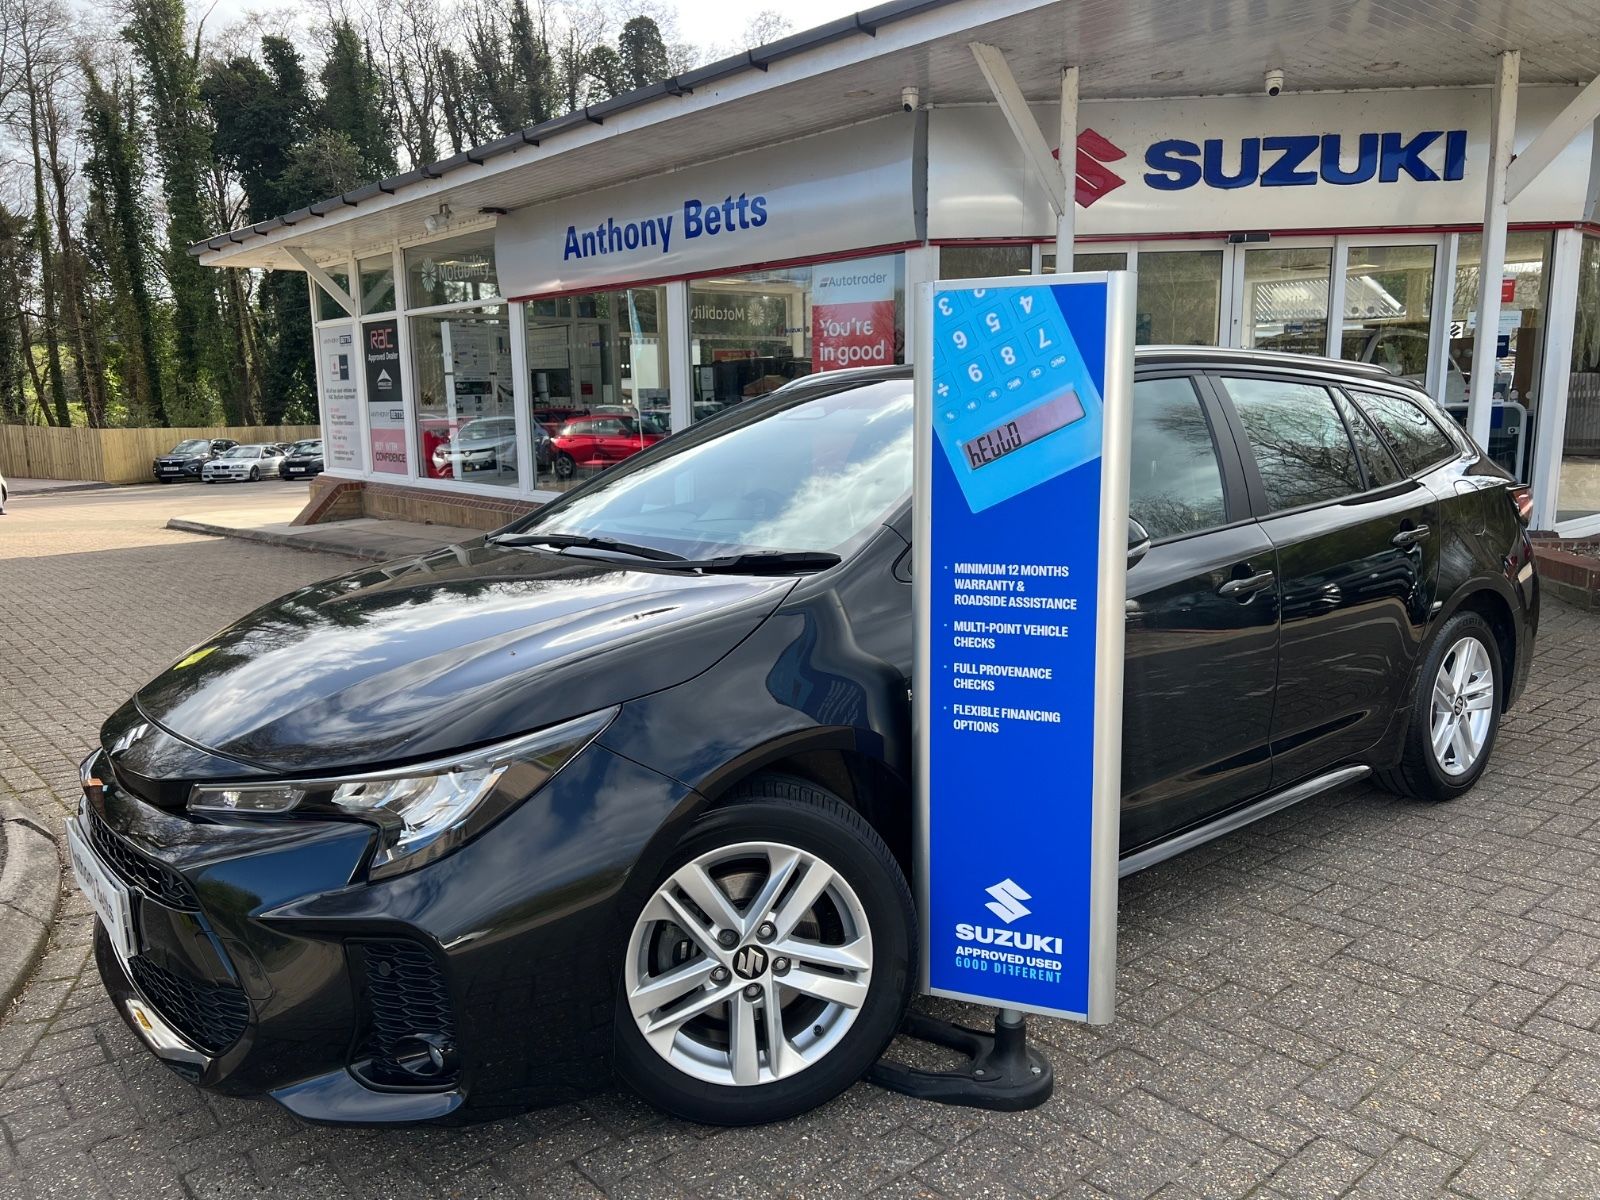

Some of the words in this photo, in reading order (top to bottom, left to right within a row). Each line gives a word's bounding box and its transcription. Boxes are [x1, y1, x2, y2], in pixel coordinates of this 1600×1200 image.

[1144, 130, 1467, 190] SUZUKI
[564, 217, 673, 260] Anthony
[684, 192, 767, 239] Betts
[828, 273, 887, 288] Autotrader
[938, 297, 953, 316] 3
[1020, 295, 1033, 314] 4
[821, 317, 873, 337] You're
[985, 312, 1001, 333] 5
[1038, 328, 1052, 349] 7
[820, 343, 836, 361] in
[837, 339, 885, 366] good
[1000, 345, 1016, 365] 8
[375, 452, 406, 463] CONFIDENCE
[954, 563, 1006, 575] MINIMUM
[1007, 564, 1019, 576] 12
[1020, 565, 1069, 578] MONTHS
[954, 578, 1016, 591] WARRANTY
[1016, 581, 1025, 592] &
[954, 594, 1007, 607] ROADSIDE
[1008, 596, 1077, 610] ASSISTANCE
[954, 621, 1021, 635] MULTI-POINT
[1023, 624, 1068, 637] VEHICLE
[954, 636, 996, 649] CHECKS
[954, 663, 980, 675] FULL
[980, 664, 1052, 679] PROVENANCE
[954, 678, 995, 691] CHECKS
[954, 704, 1000, 718] FLEXIBLE
[1001, 708, 1061, 723] FINANCING
[954, 719, 999, 733] OPTIONS
[955, 923, 1063, 955] SUZUKI
[956, 946, 1025, 965] APPROVED
[1026, 955, 1062, 971] USED
[955, 956, 988, 971] GOOD
[994, 963, 1062, 984] DIFFERENT
